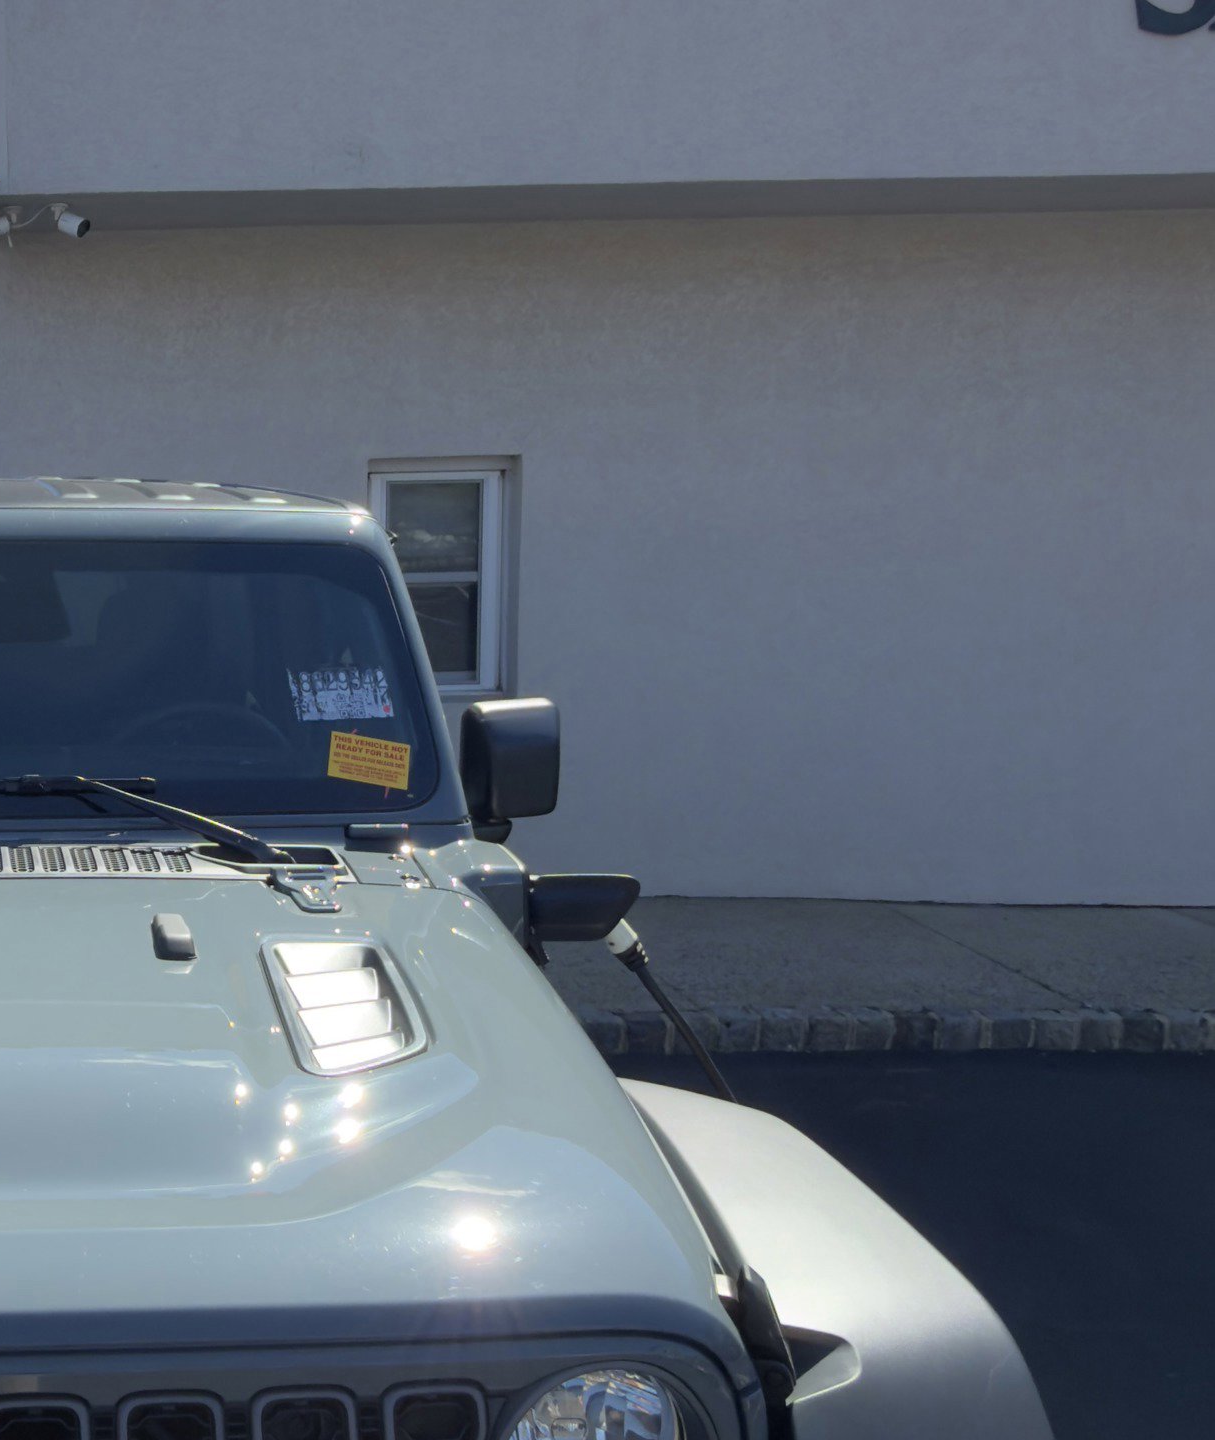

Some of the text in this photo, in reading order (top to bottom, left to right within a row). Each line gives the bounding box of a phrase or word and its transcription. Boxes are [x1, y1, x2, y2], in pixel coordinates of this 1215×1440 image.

[333, 734, 409, 754] THIS VEHICLE NOT
[336, 743, 363, 753] READY
[365, 748, 382, 757] FOR
[384, 752, 405, 762] SALE
